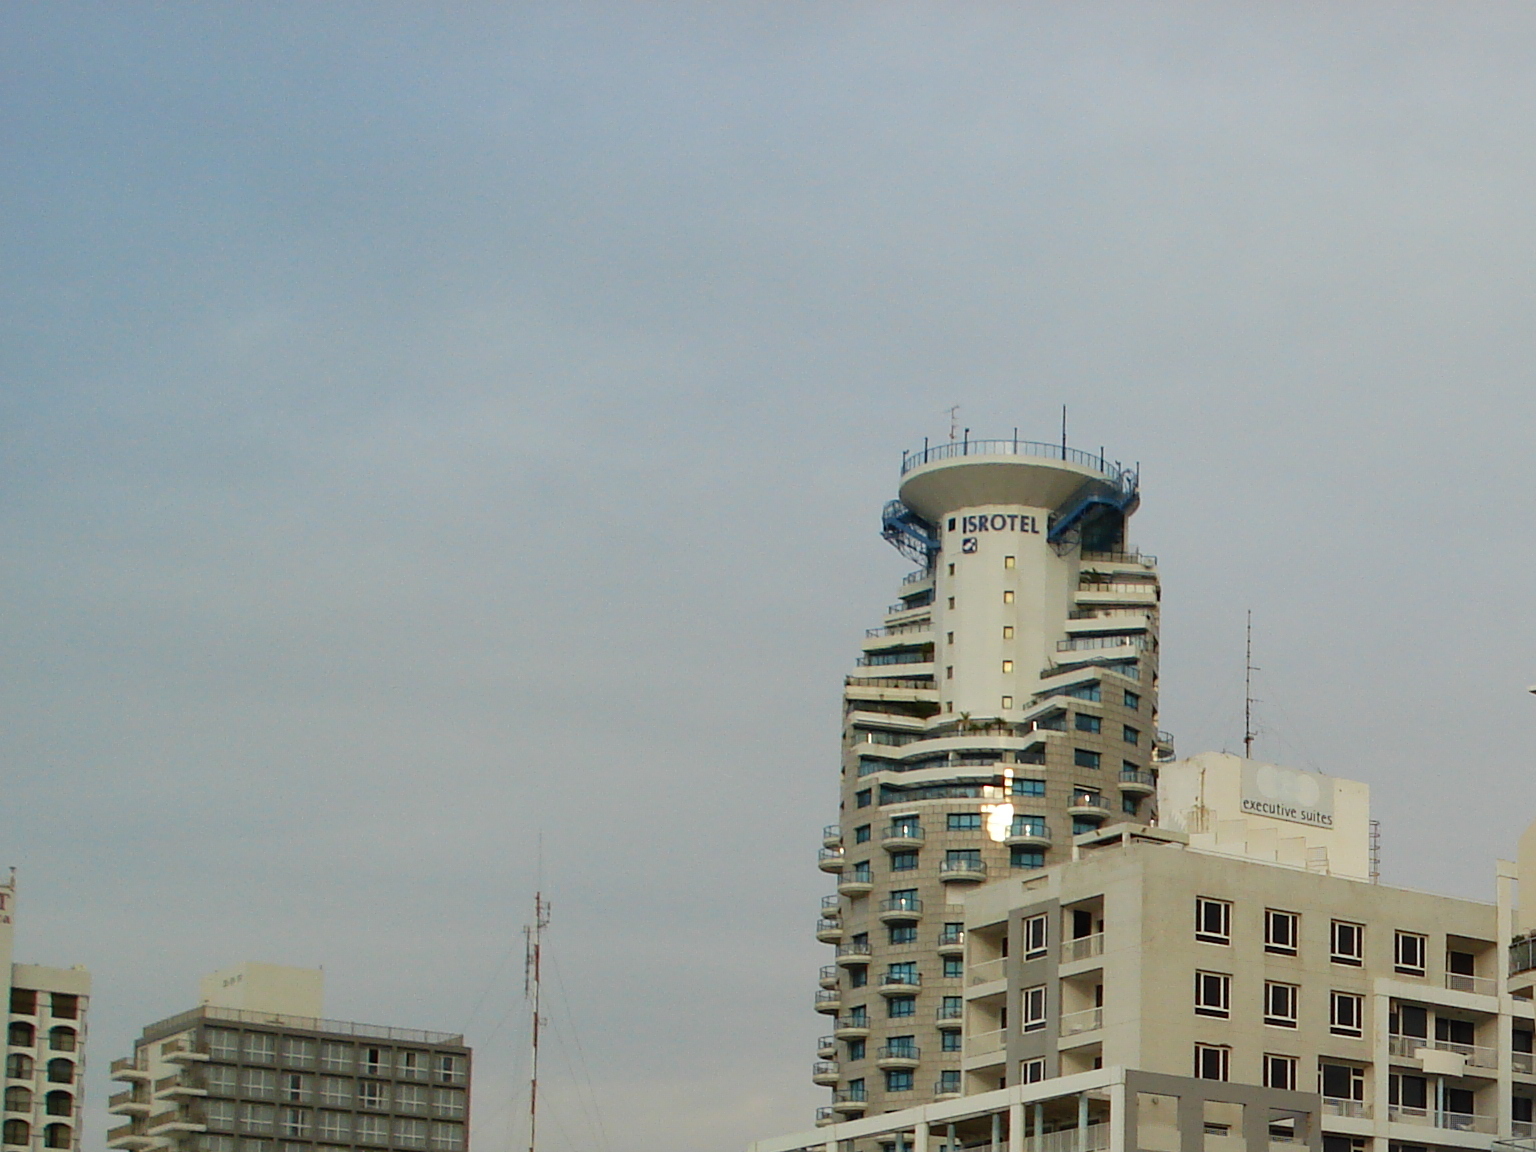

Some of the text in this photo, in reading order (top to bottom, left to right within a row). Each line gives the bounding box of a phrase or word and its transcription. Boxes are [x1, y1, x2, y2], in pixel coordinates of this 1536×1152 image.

[963, 514, 1040, 534] ISROTEL
[1243, 799, 1333, 825] executive suites
